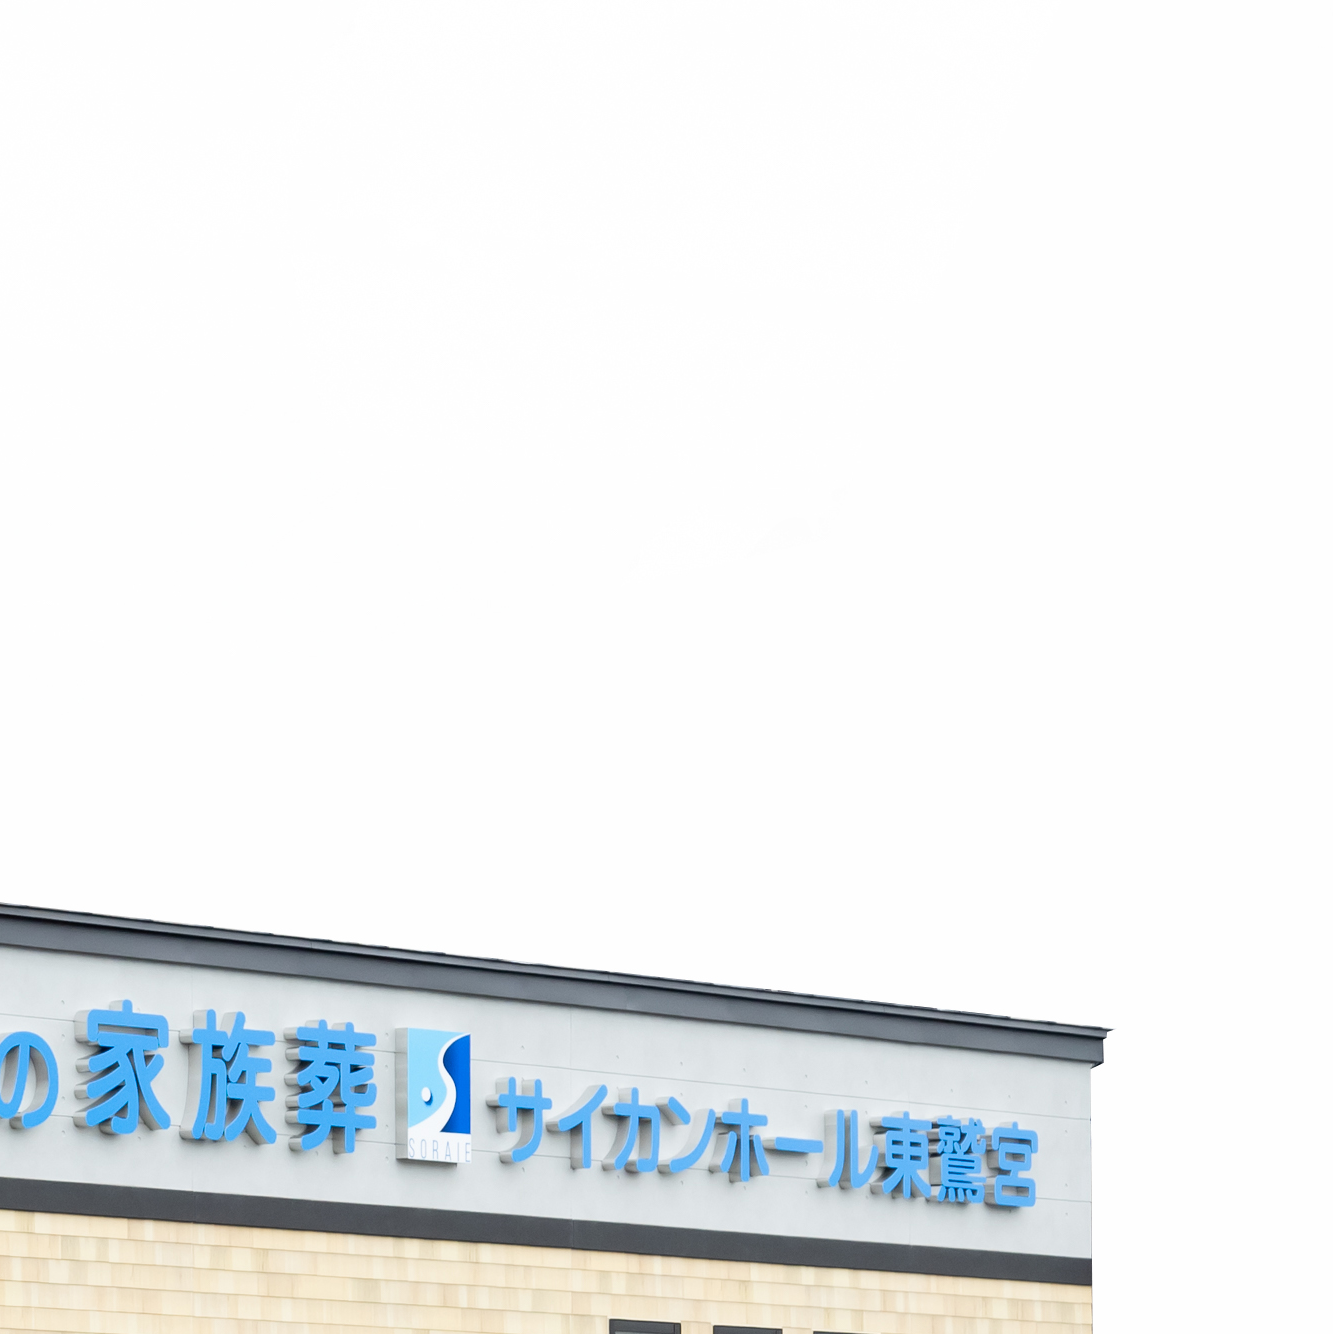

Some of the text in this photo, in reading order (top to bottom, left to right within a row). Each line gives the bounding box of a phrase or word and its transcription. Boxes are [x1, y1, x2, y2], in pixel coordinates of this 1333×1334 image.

[409, 1138, 471, 1163] SORAIE
[491, 1075, 1038, 1208] サイカンホール東鷲宮
